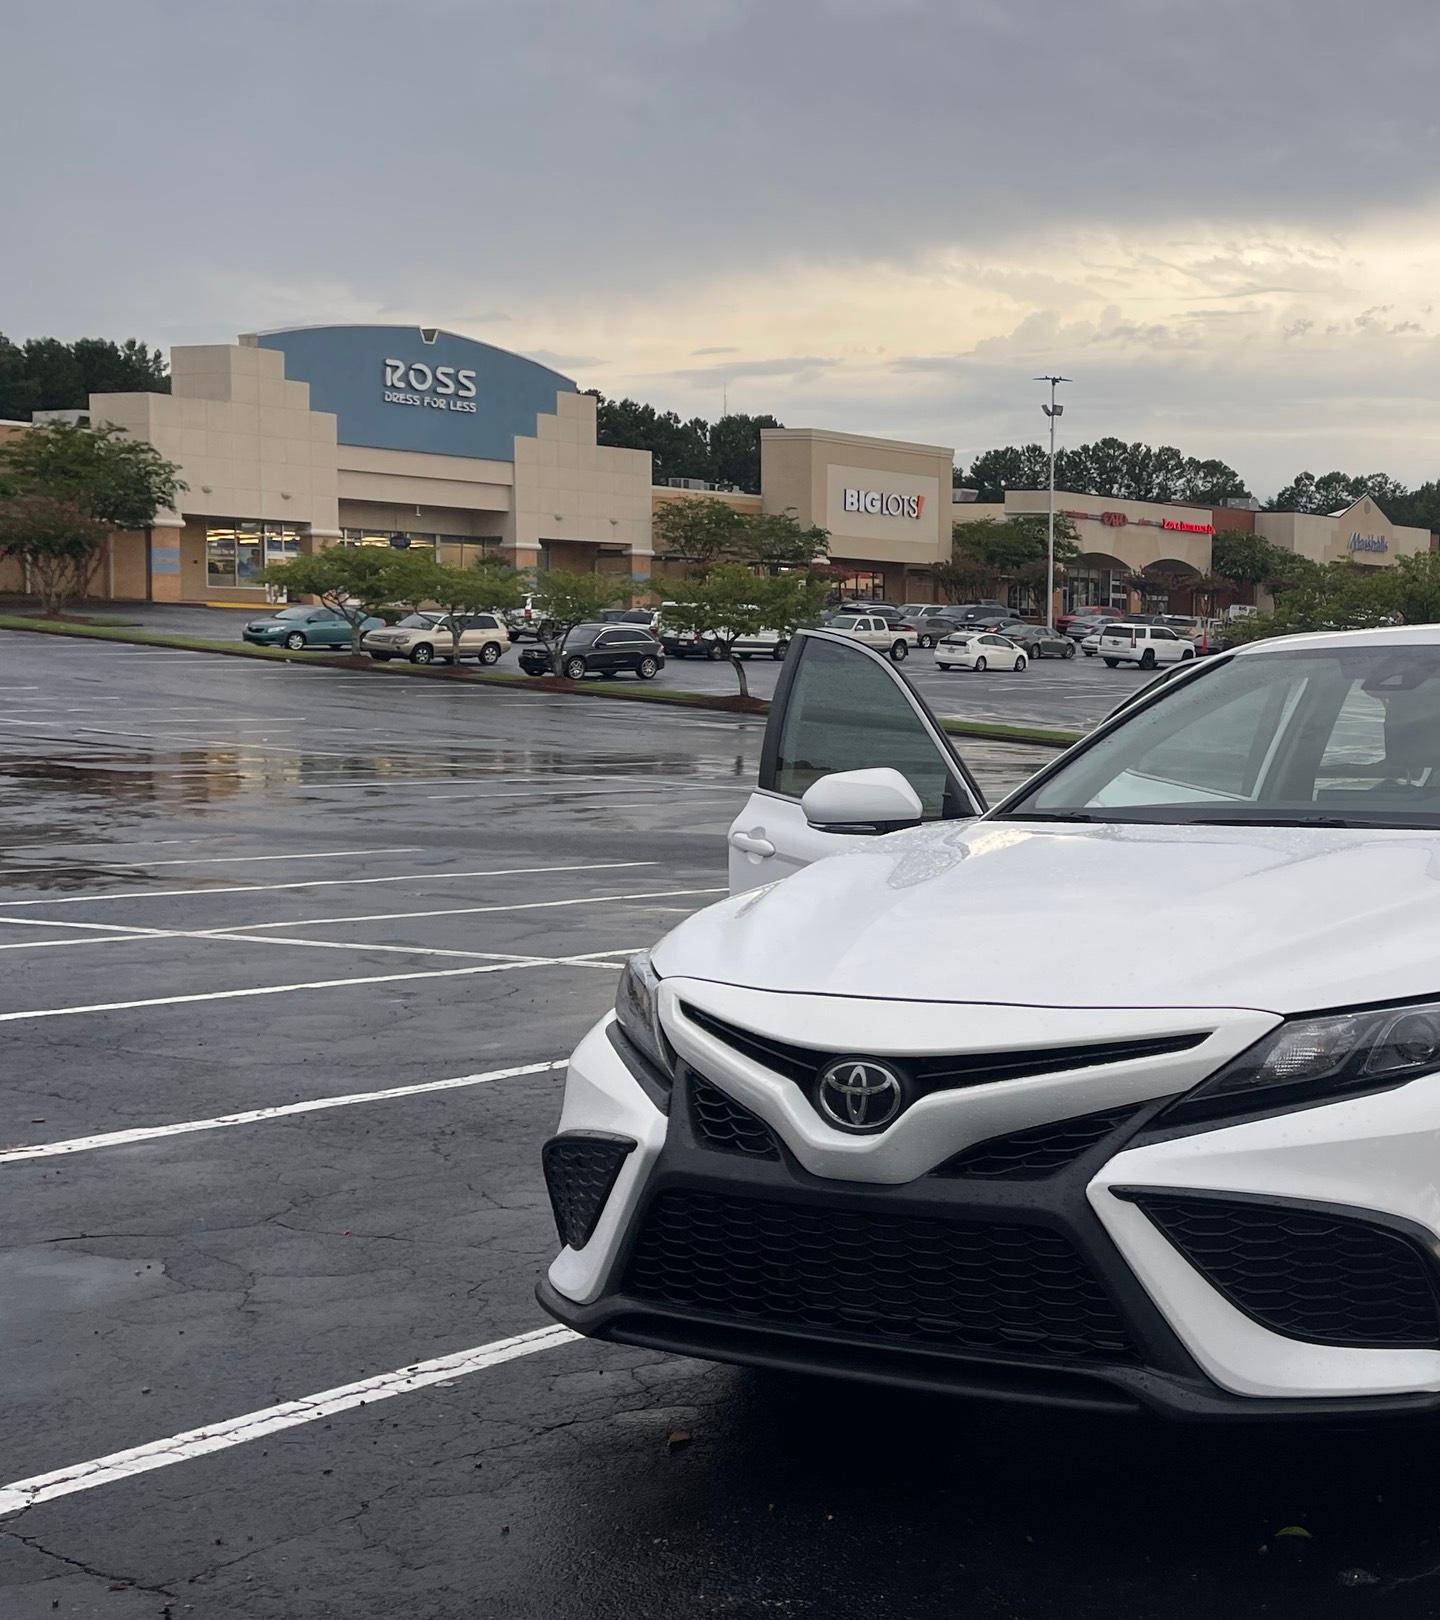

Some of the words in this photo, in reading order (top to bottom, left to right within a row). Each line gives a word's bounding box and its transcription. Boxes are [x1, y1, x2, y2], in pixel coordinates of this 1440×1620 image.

[384, 359, 477, 397] ROSS
[384, 391, 420, 406] DRESS
[424, 396, 446, 409] FOR
[450, 400, 477, 413] LESS
